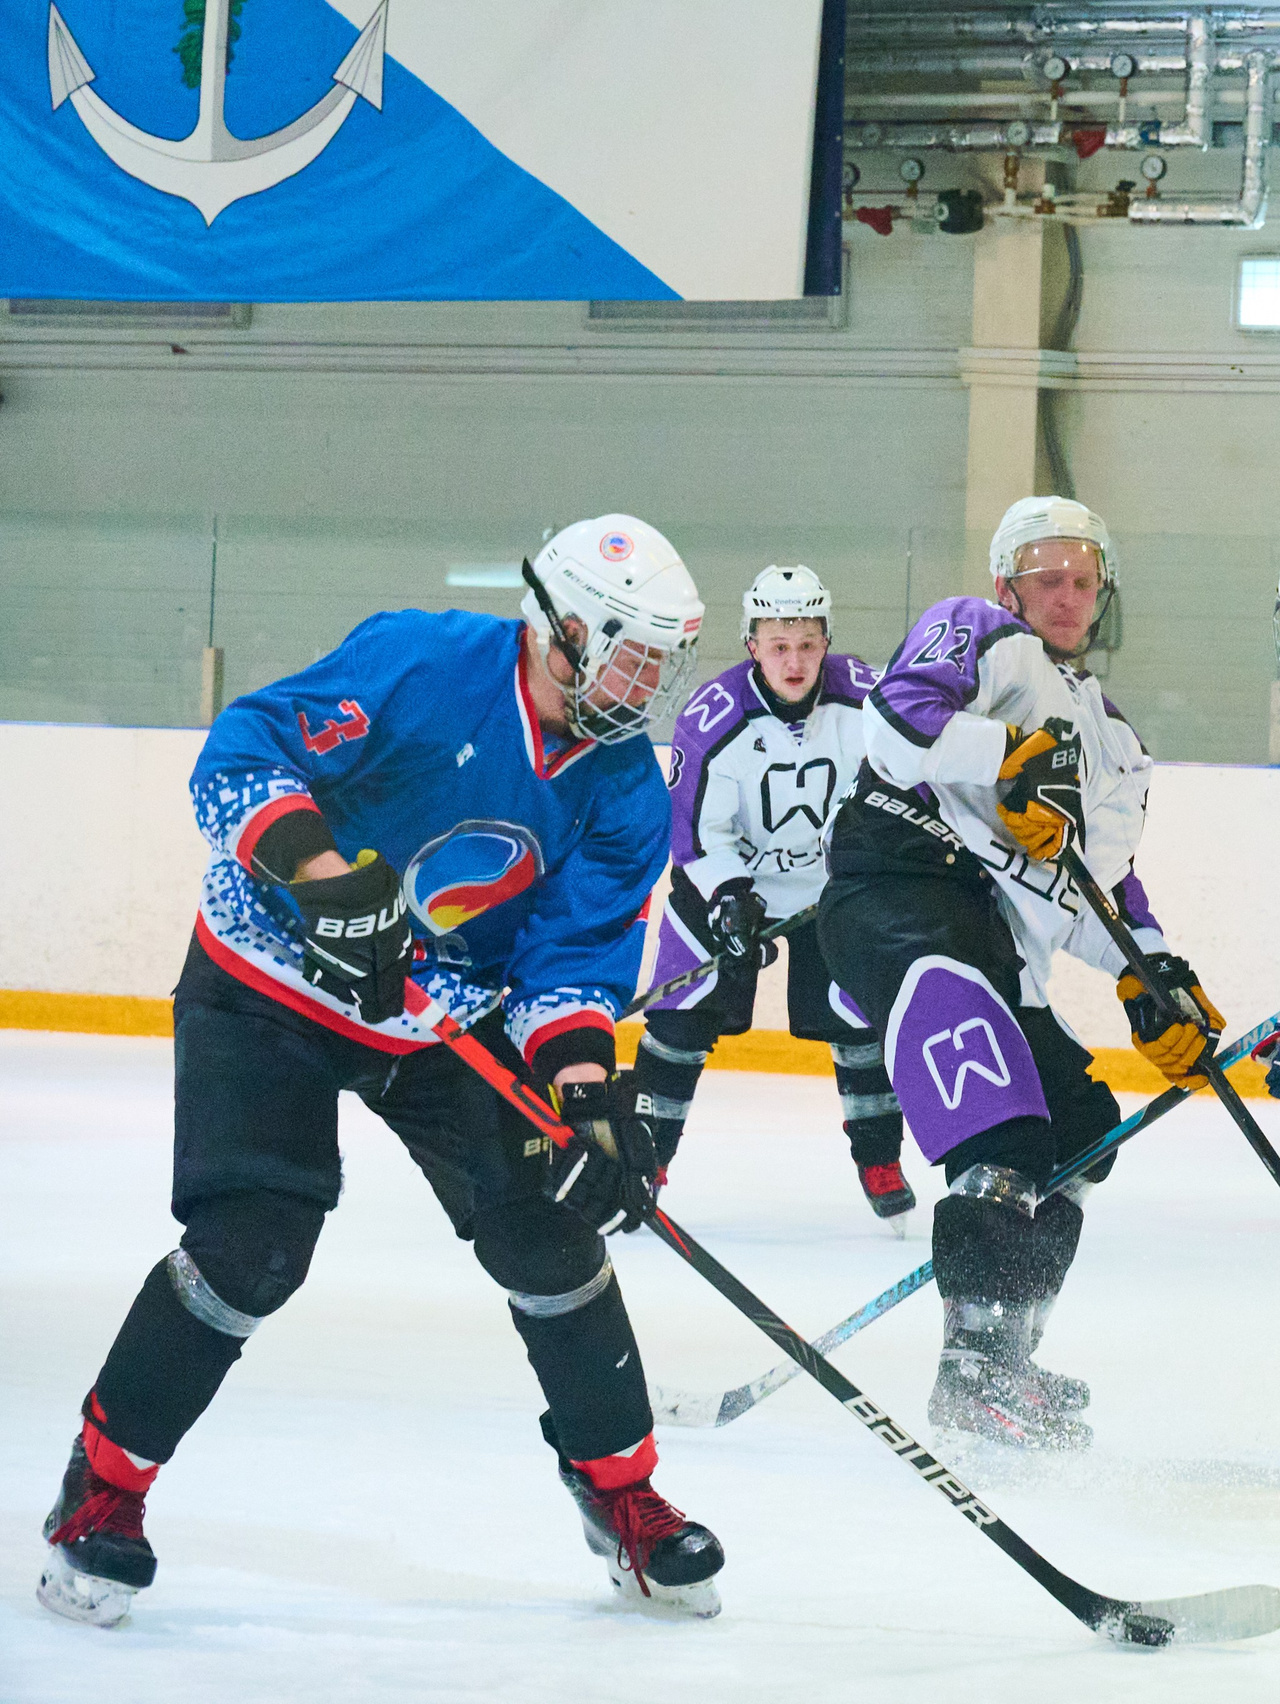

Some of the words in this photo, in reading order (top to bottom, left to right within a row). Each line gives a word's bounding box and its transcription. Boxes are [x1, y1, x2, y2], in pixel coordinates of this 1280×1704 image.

[908, 619, 973, 674] 22
[864, 790, 965, 851] BAUER
[842, 1394, 998, 1529] BAUER
